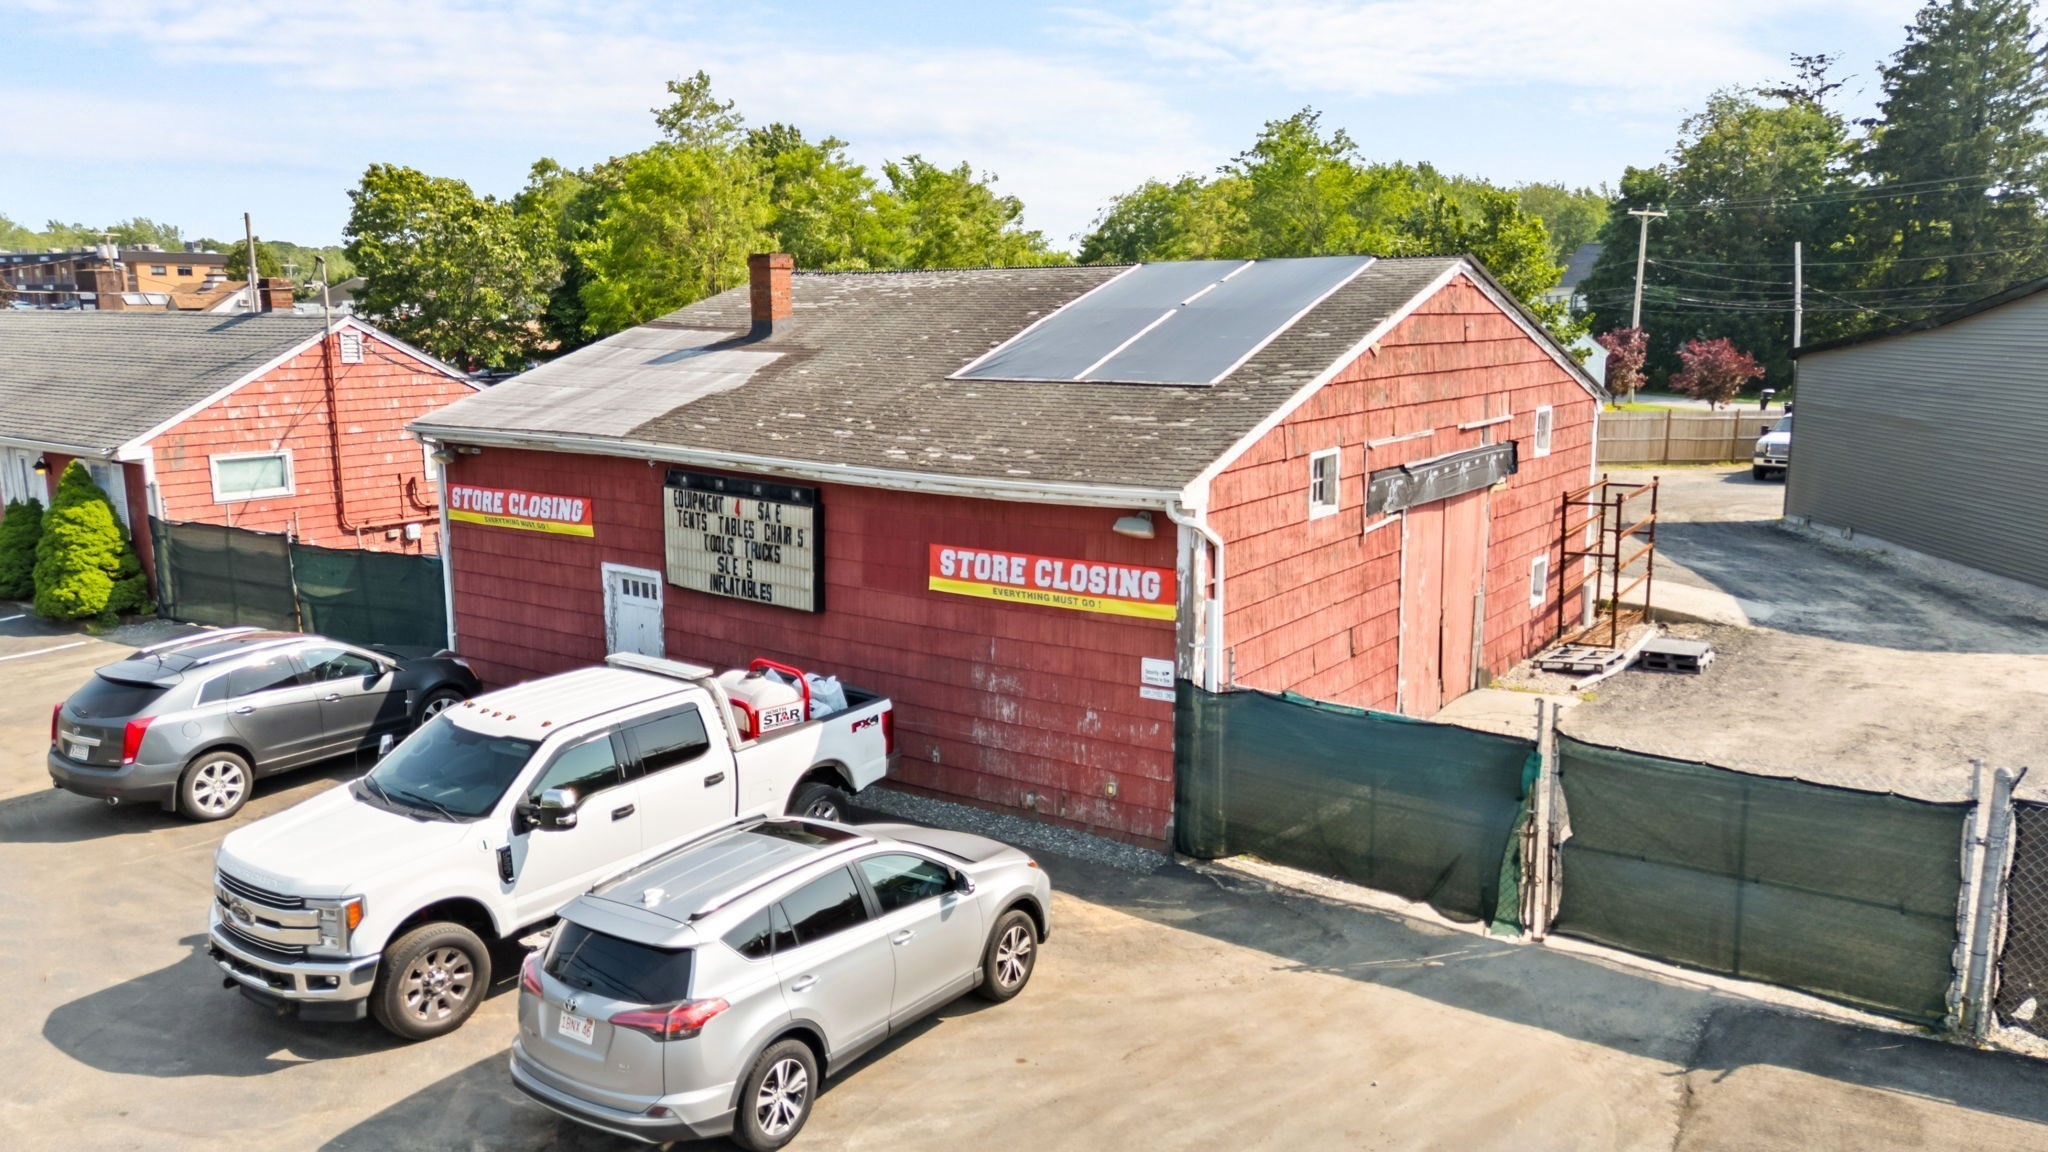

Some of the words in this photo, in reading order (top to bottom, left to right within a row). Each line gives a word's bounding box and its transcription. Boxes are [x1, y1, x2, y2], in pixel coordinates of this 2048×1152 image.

[452, 487, 504, 514] STORE
[508, 493, 583, 522] CLOSING
[673, 489, 724, 514] EQUIPMENT
[734, 499, 741, 517] 4
[677, 509, 707, 531] TENTS
[718, 516, 755, 540] TABLES
[703, 533, 734, 555] TOOLS
[744, 539, 781, 564] TRUCKS
[710, 574, 772, 602] INFLATABLES
[940, 549, 1027, 585] STORE
[1034, 559, 1161, 601] CLOSING
[992, 587, 1050, 602] EVERYTHING
[1052, 594, 1078, 606] MUST
[763, 708, 800, 725] STAR
[851, 714, 879, 733] FX4
